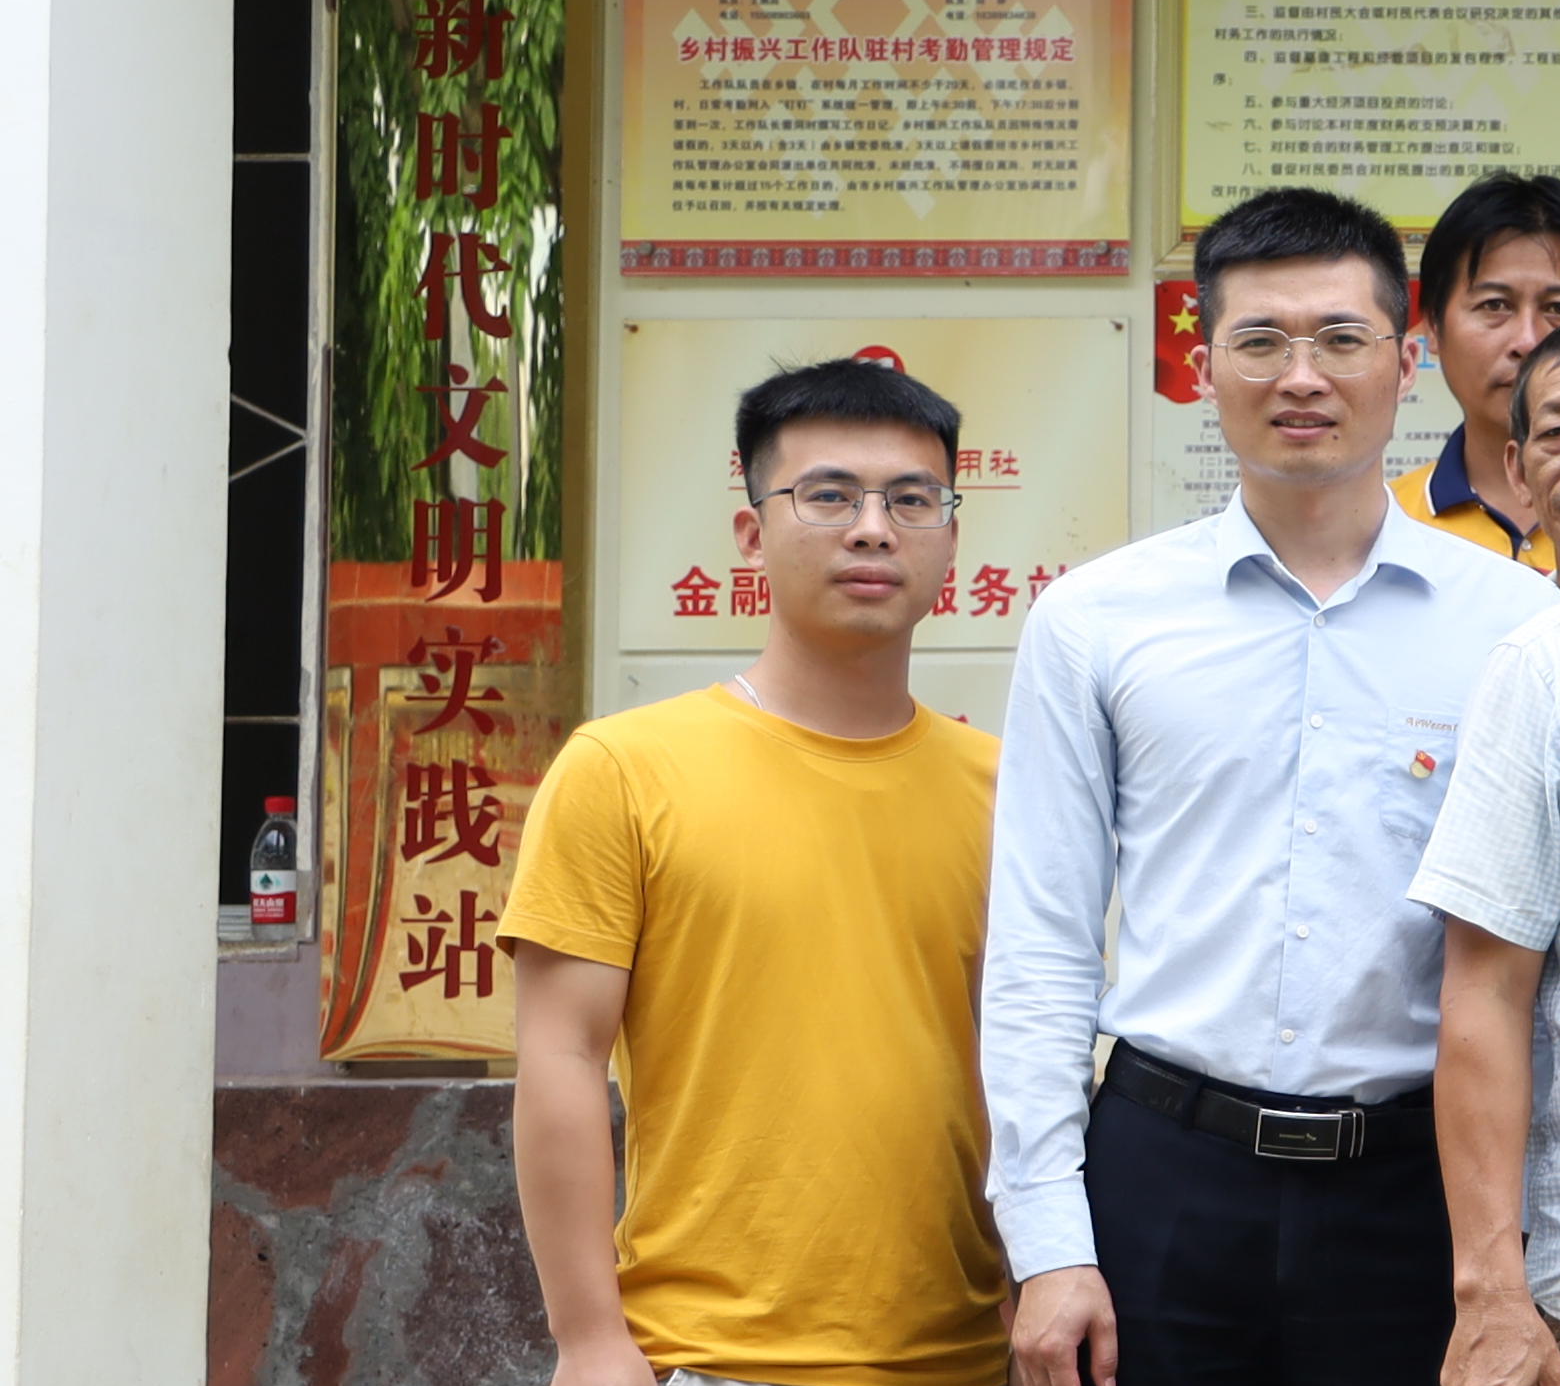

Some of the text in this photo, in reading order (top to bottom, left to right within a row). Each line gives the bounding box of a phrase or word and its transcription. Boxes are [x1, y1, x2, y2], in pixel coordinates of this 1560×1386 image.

[679, 37, 1075, 63] 乡村振兴工作队驻村考勤管理规定
